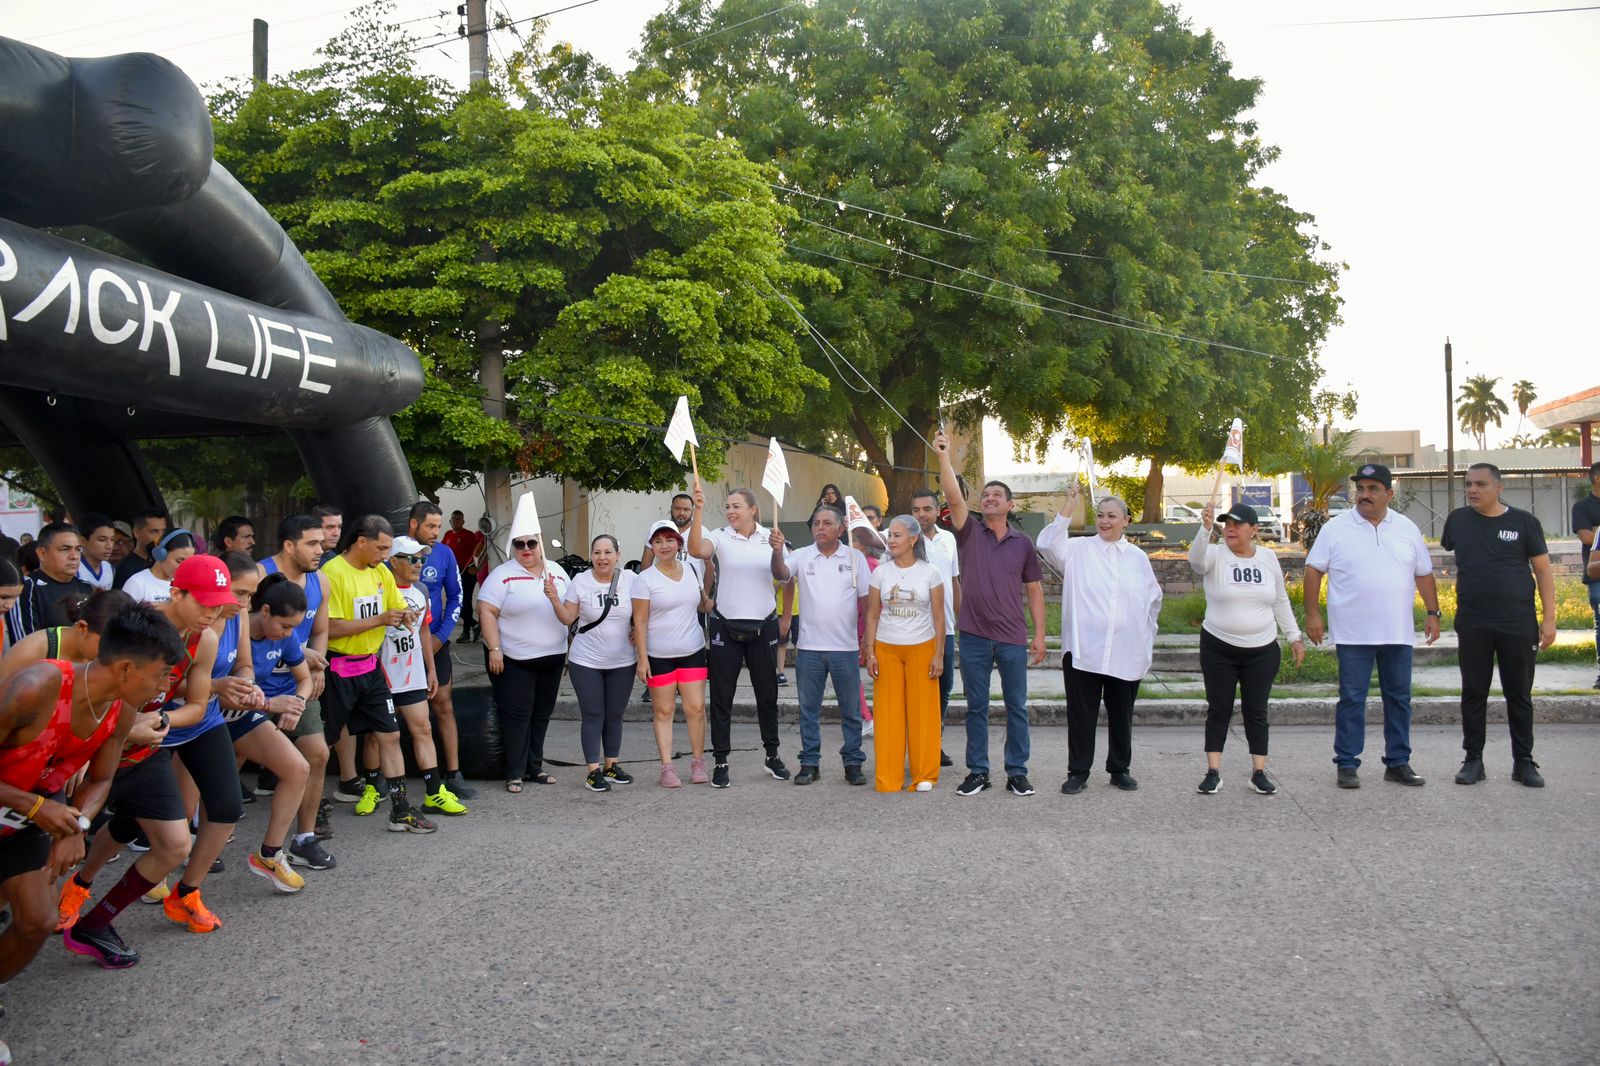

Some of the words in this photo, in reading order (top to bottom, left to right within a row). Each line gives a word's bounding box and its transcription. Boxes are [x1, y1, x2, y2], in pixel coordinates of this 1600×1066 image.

[203, 300, 337, 394] LIFE
[1497, 529, 1519, 541] AERO
[214, 568, 227, 587] LA
[1233, 567, 1262, 583] 089
[360, 601, 379, 619] 074
[393, 634, 415, 654] 165
